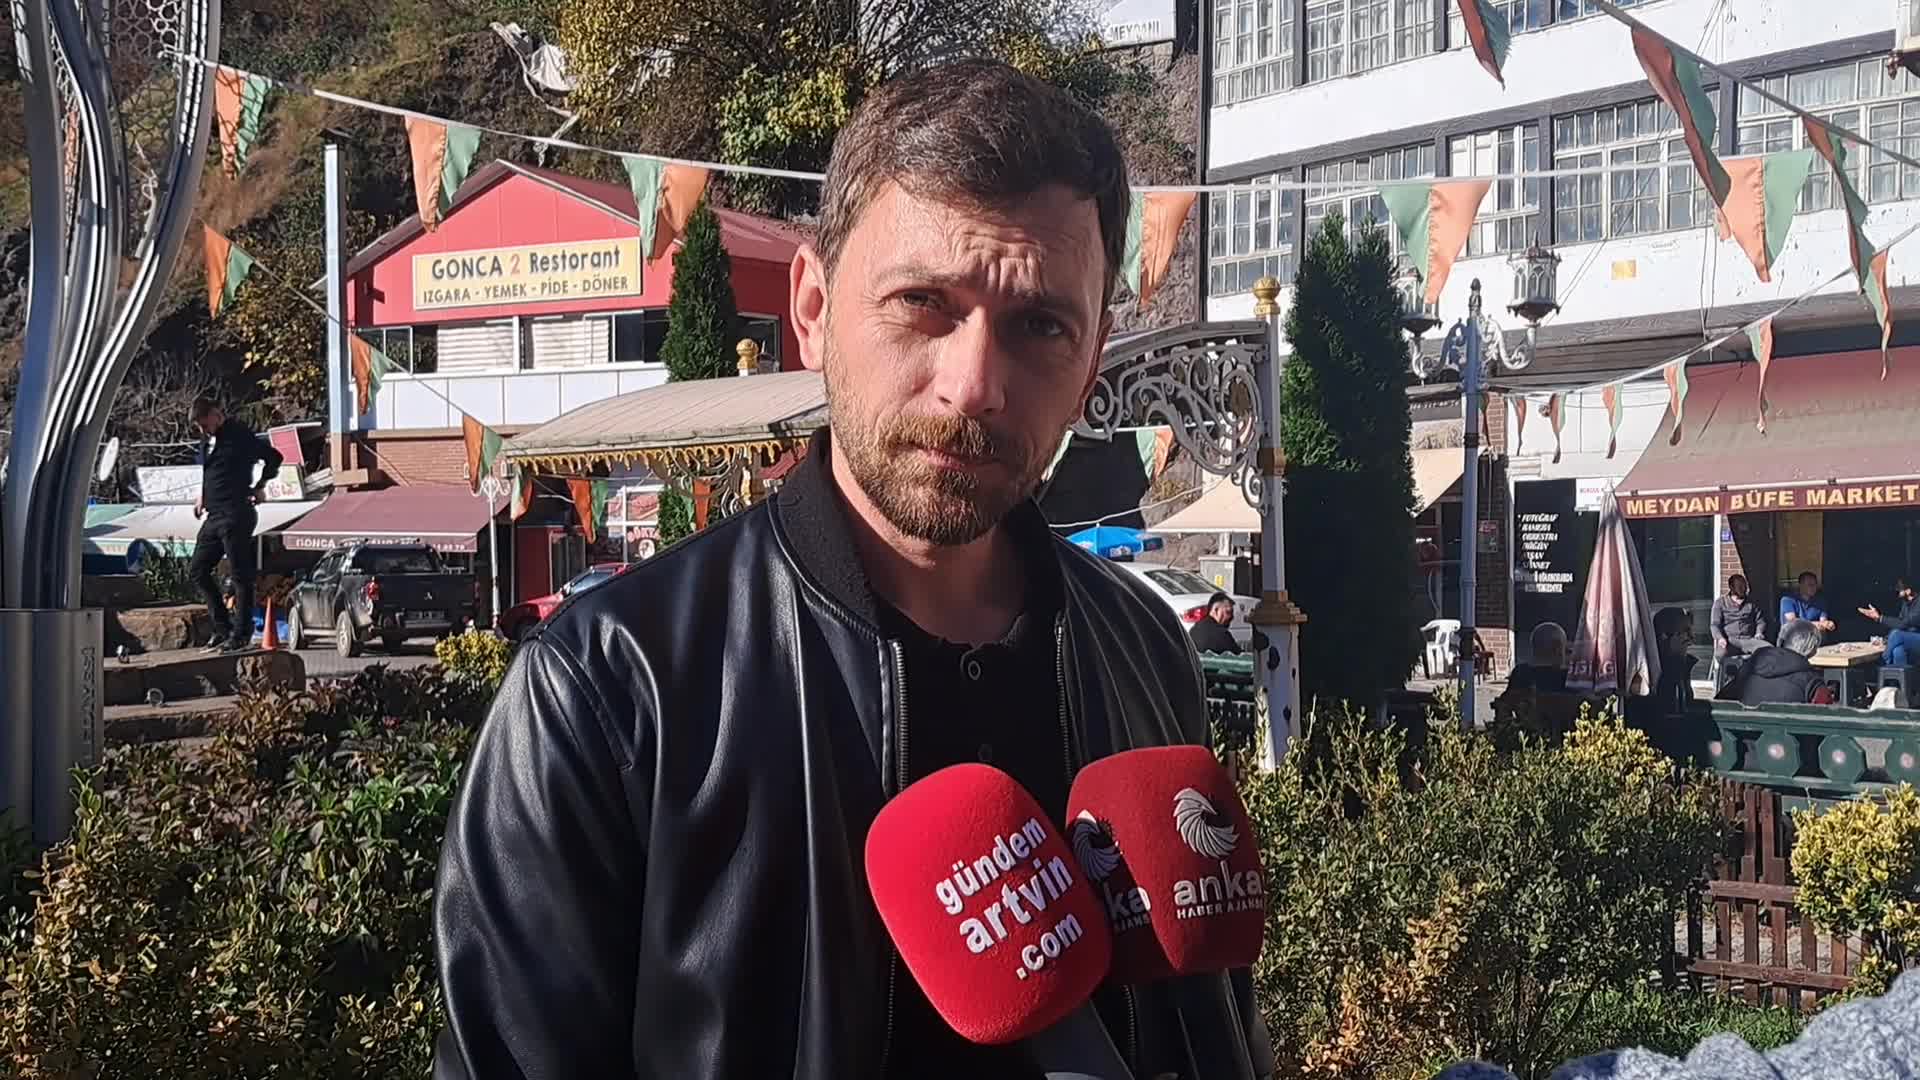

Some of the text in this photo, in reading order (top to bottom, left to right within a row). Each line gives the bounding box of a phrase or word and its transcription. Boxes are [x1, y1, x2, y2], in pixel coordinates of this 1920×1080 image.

[432, 245, 621, 280] GONCA 2 Restorant
[423, 274, 628, 304] IZGARA YEMEK PİDE DÖNER
[1626, 484, 1920, 516] MEYDAN BÜFE MARKET
[935, 816, 1048, 915] gündem
[1173, 860, 1263, 906] anka
[959, 855, 1074, 955] artvin
[1176, 903, 1223, 920] HABER
[1015, 913, 1083, 981] .com
